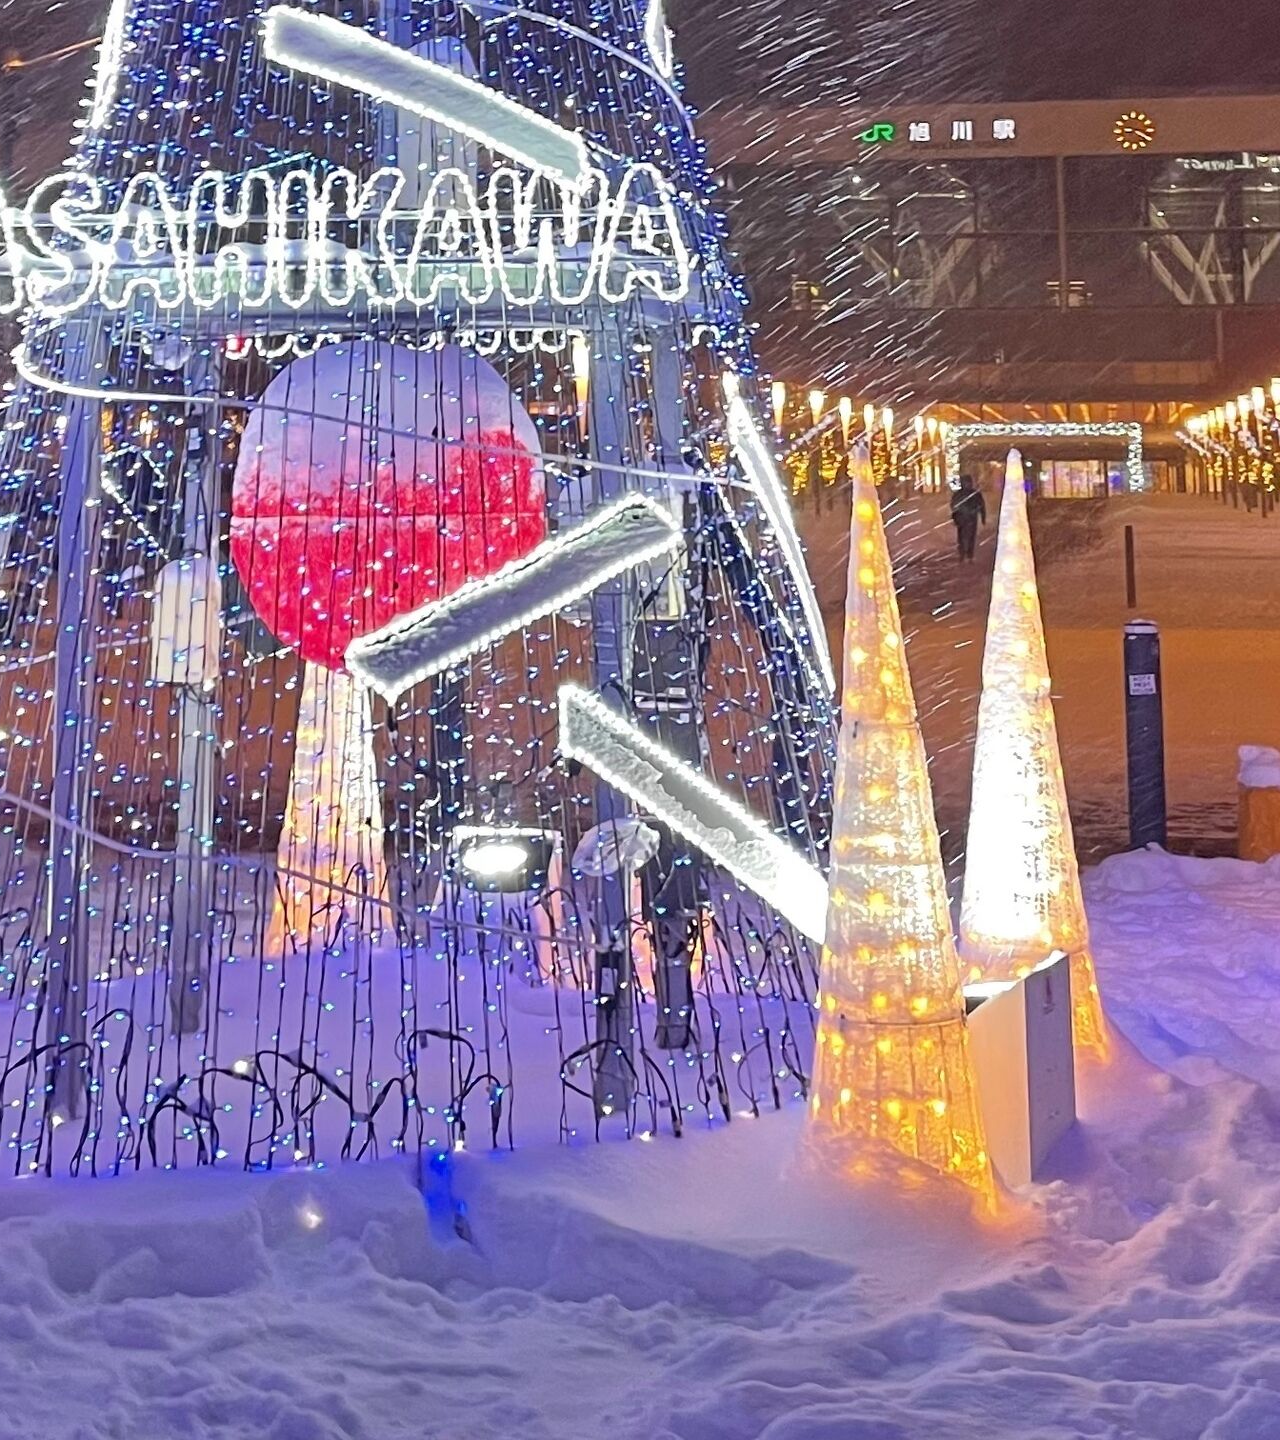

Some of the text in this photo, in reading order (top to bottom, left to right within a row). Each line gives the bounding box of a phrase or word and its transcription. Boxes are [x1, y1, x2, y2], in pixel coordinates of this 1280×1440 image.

[861, 118, 1016, 143] JR 旭川駅
